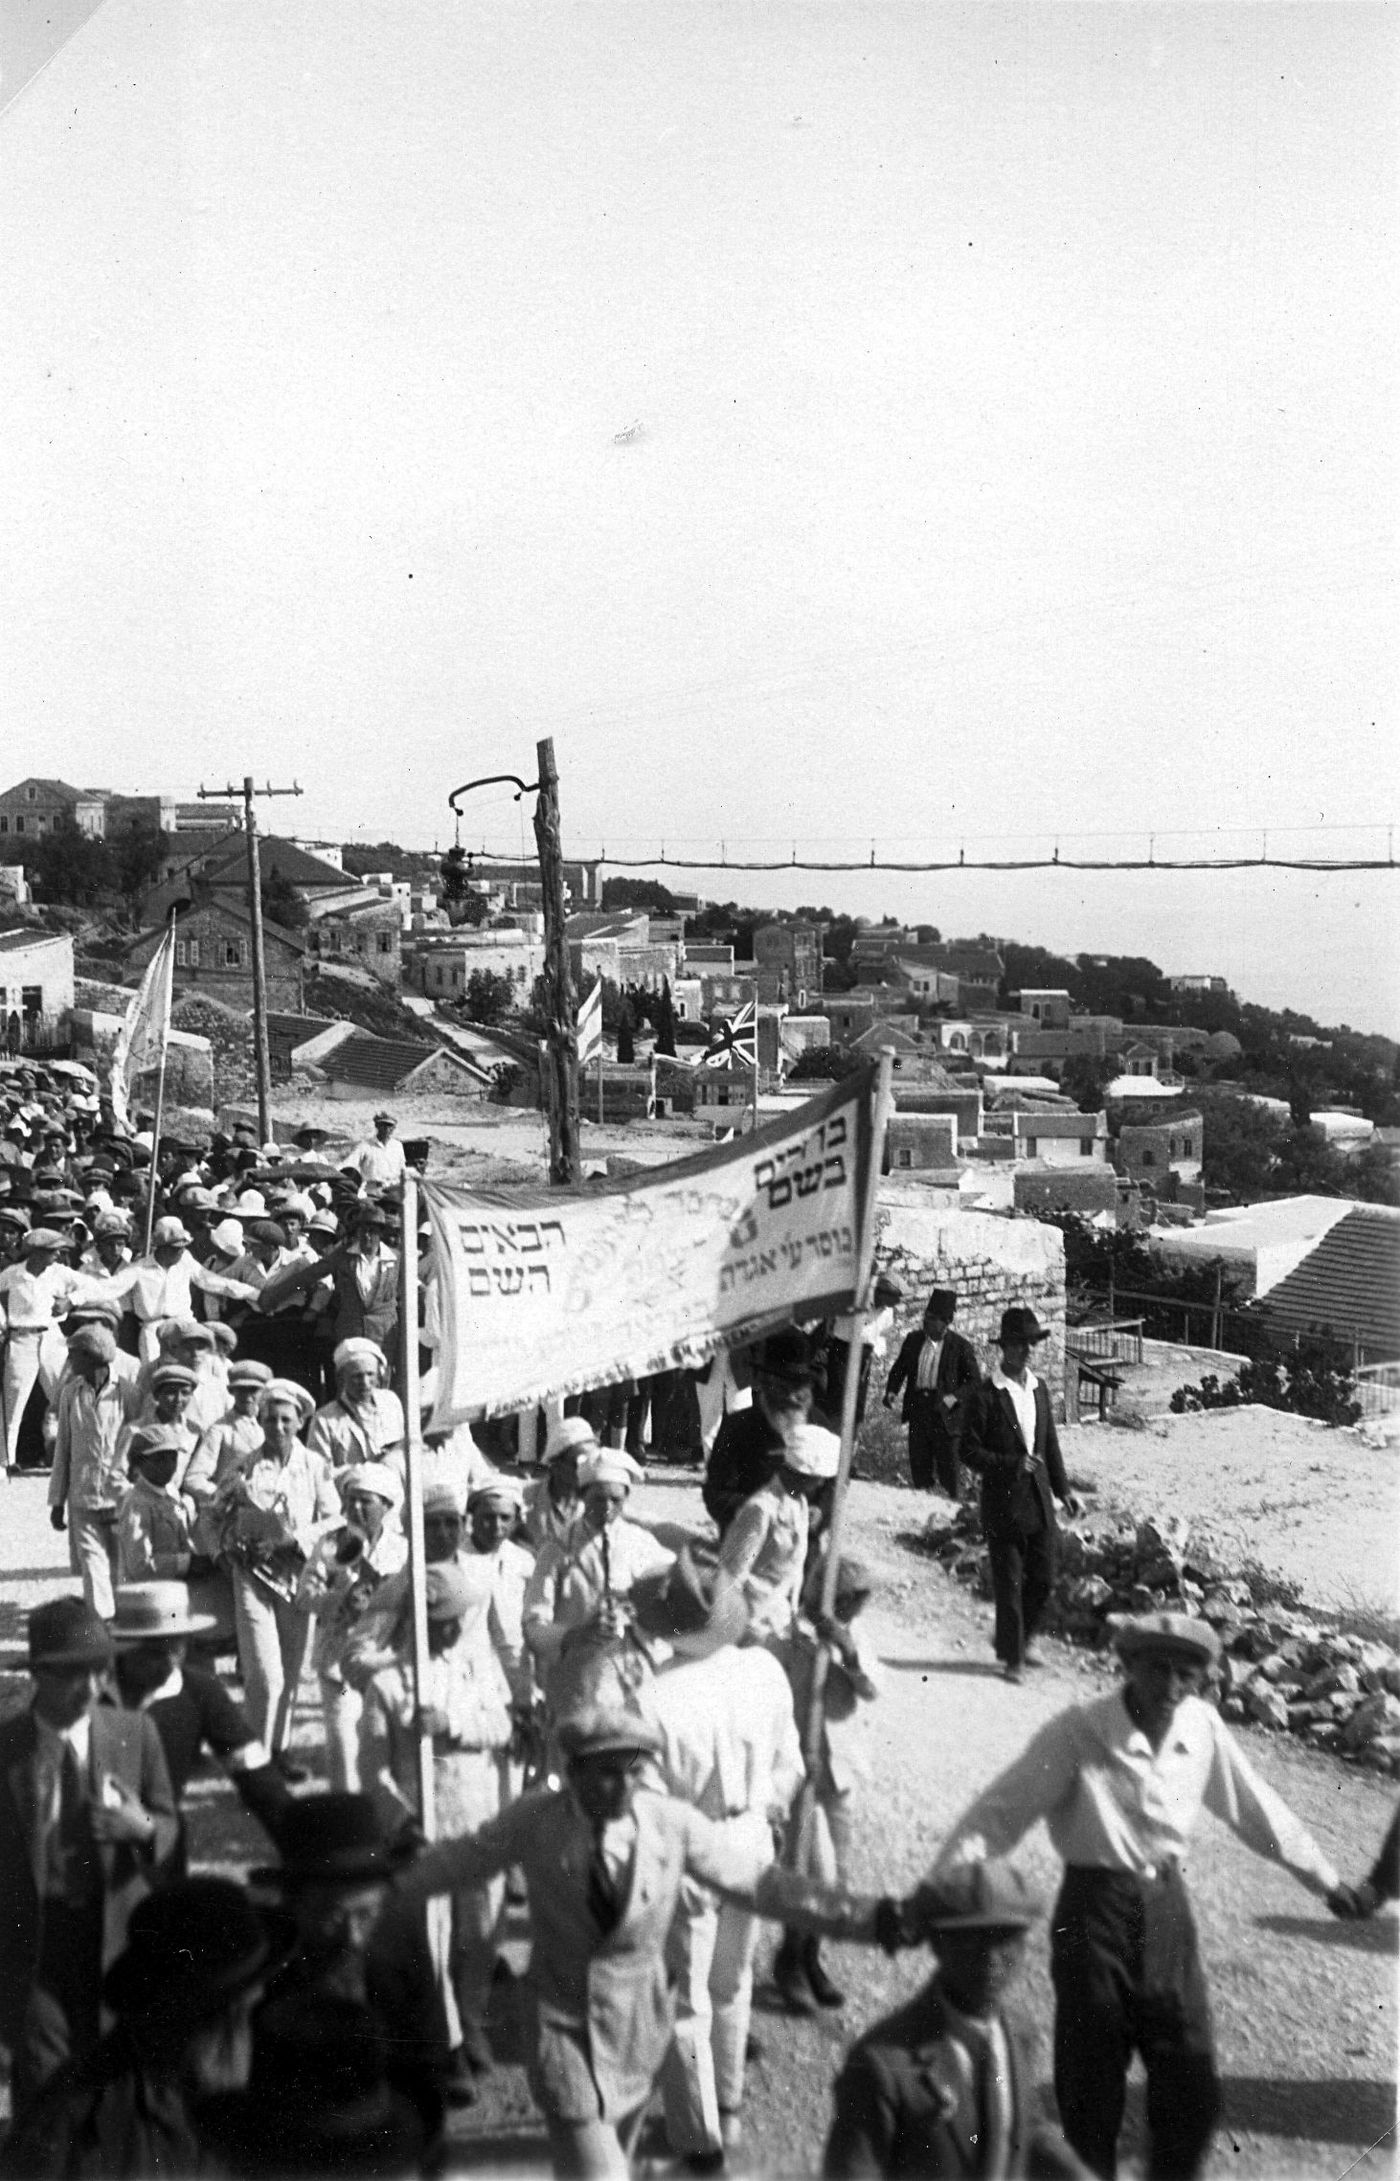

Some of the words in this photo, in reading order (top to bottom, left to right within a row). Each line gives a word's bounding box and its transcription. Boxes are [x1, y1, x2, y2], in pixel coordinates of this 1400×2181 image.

[769, 1154, 847, 1209] בשם
[459, 1220, 566, 1254] הבאים
[468, 1265, 550, 1296] השם
